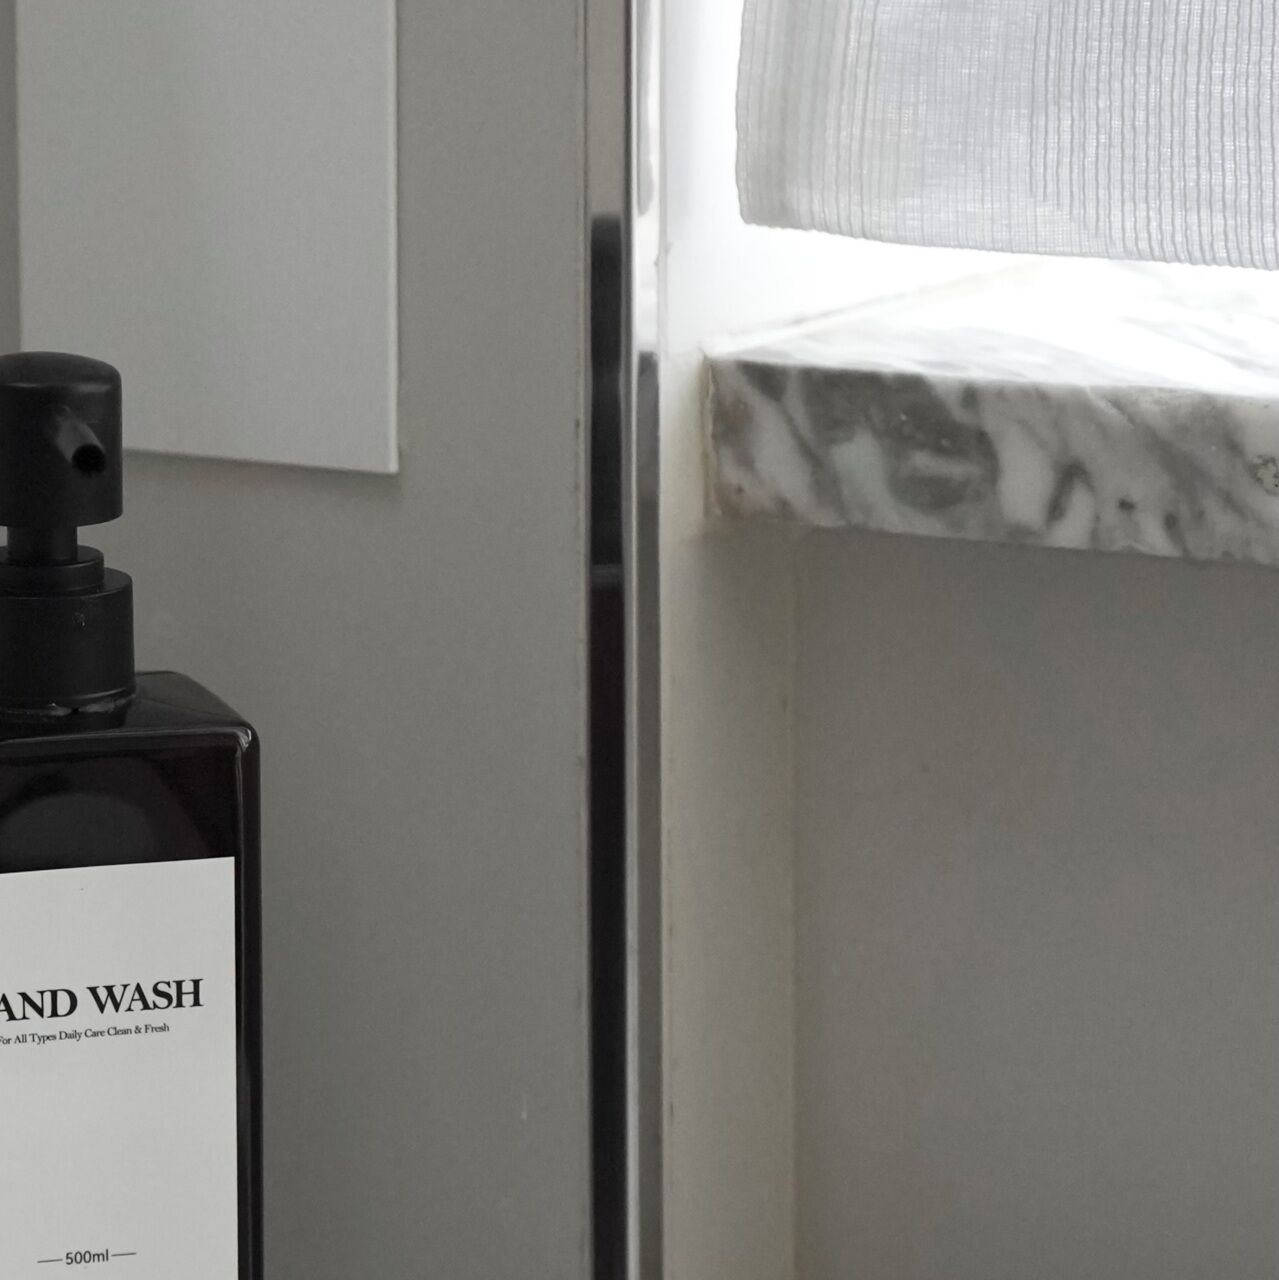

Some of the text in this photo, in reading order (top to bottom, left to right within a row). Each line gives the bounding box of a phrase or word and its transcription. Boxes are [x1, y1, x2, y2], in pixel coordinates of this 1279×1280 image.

[86, 978, 205, 1015] WASH
[14, 1033, 28, 1045] All
[29, 1032, 58, 1045] Types
[59, 1029, 83, 1042] Daily
[84, 1028, 106, 1039] Care
[107, 1026, 133, 1037] Clean
[134, 1024, 143, 1035] &
[144, 1022, 170, 1034] Fresh
[65, 1248, 110, 1266] 500ml
